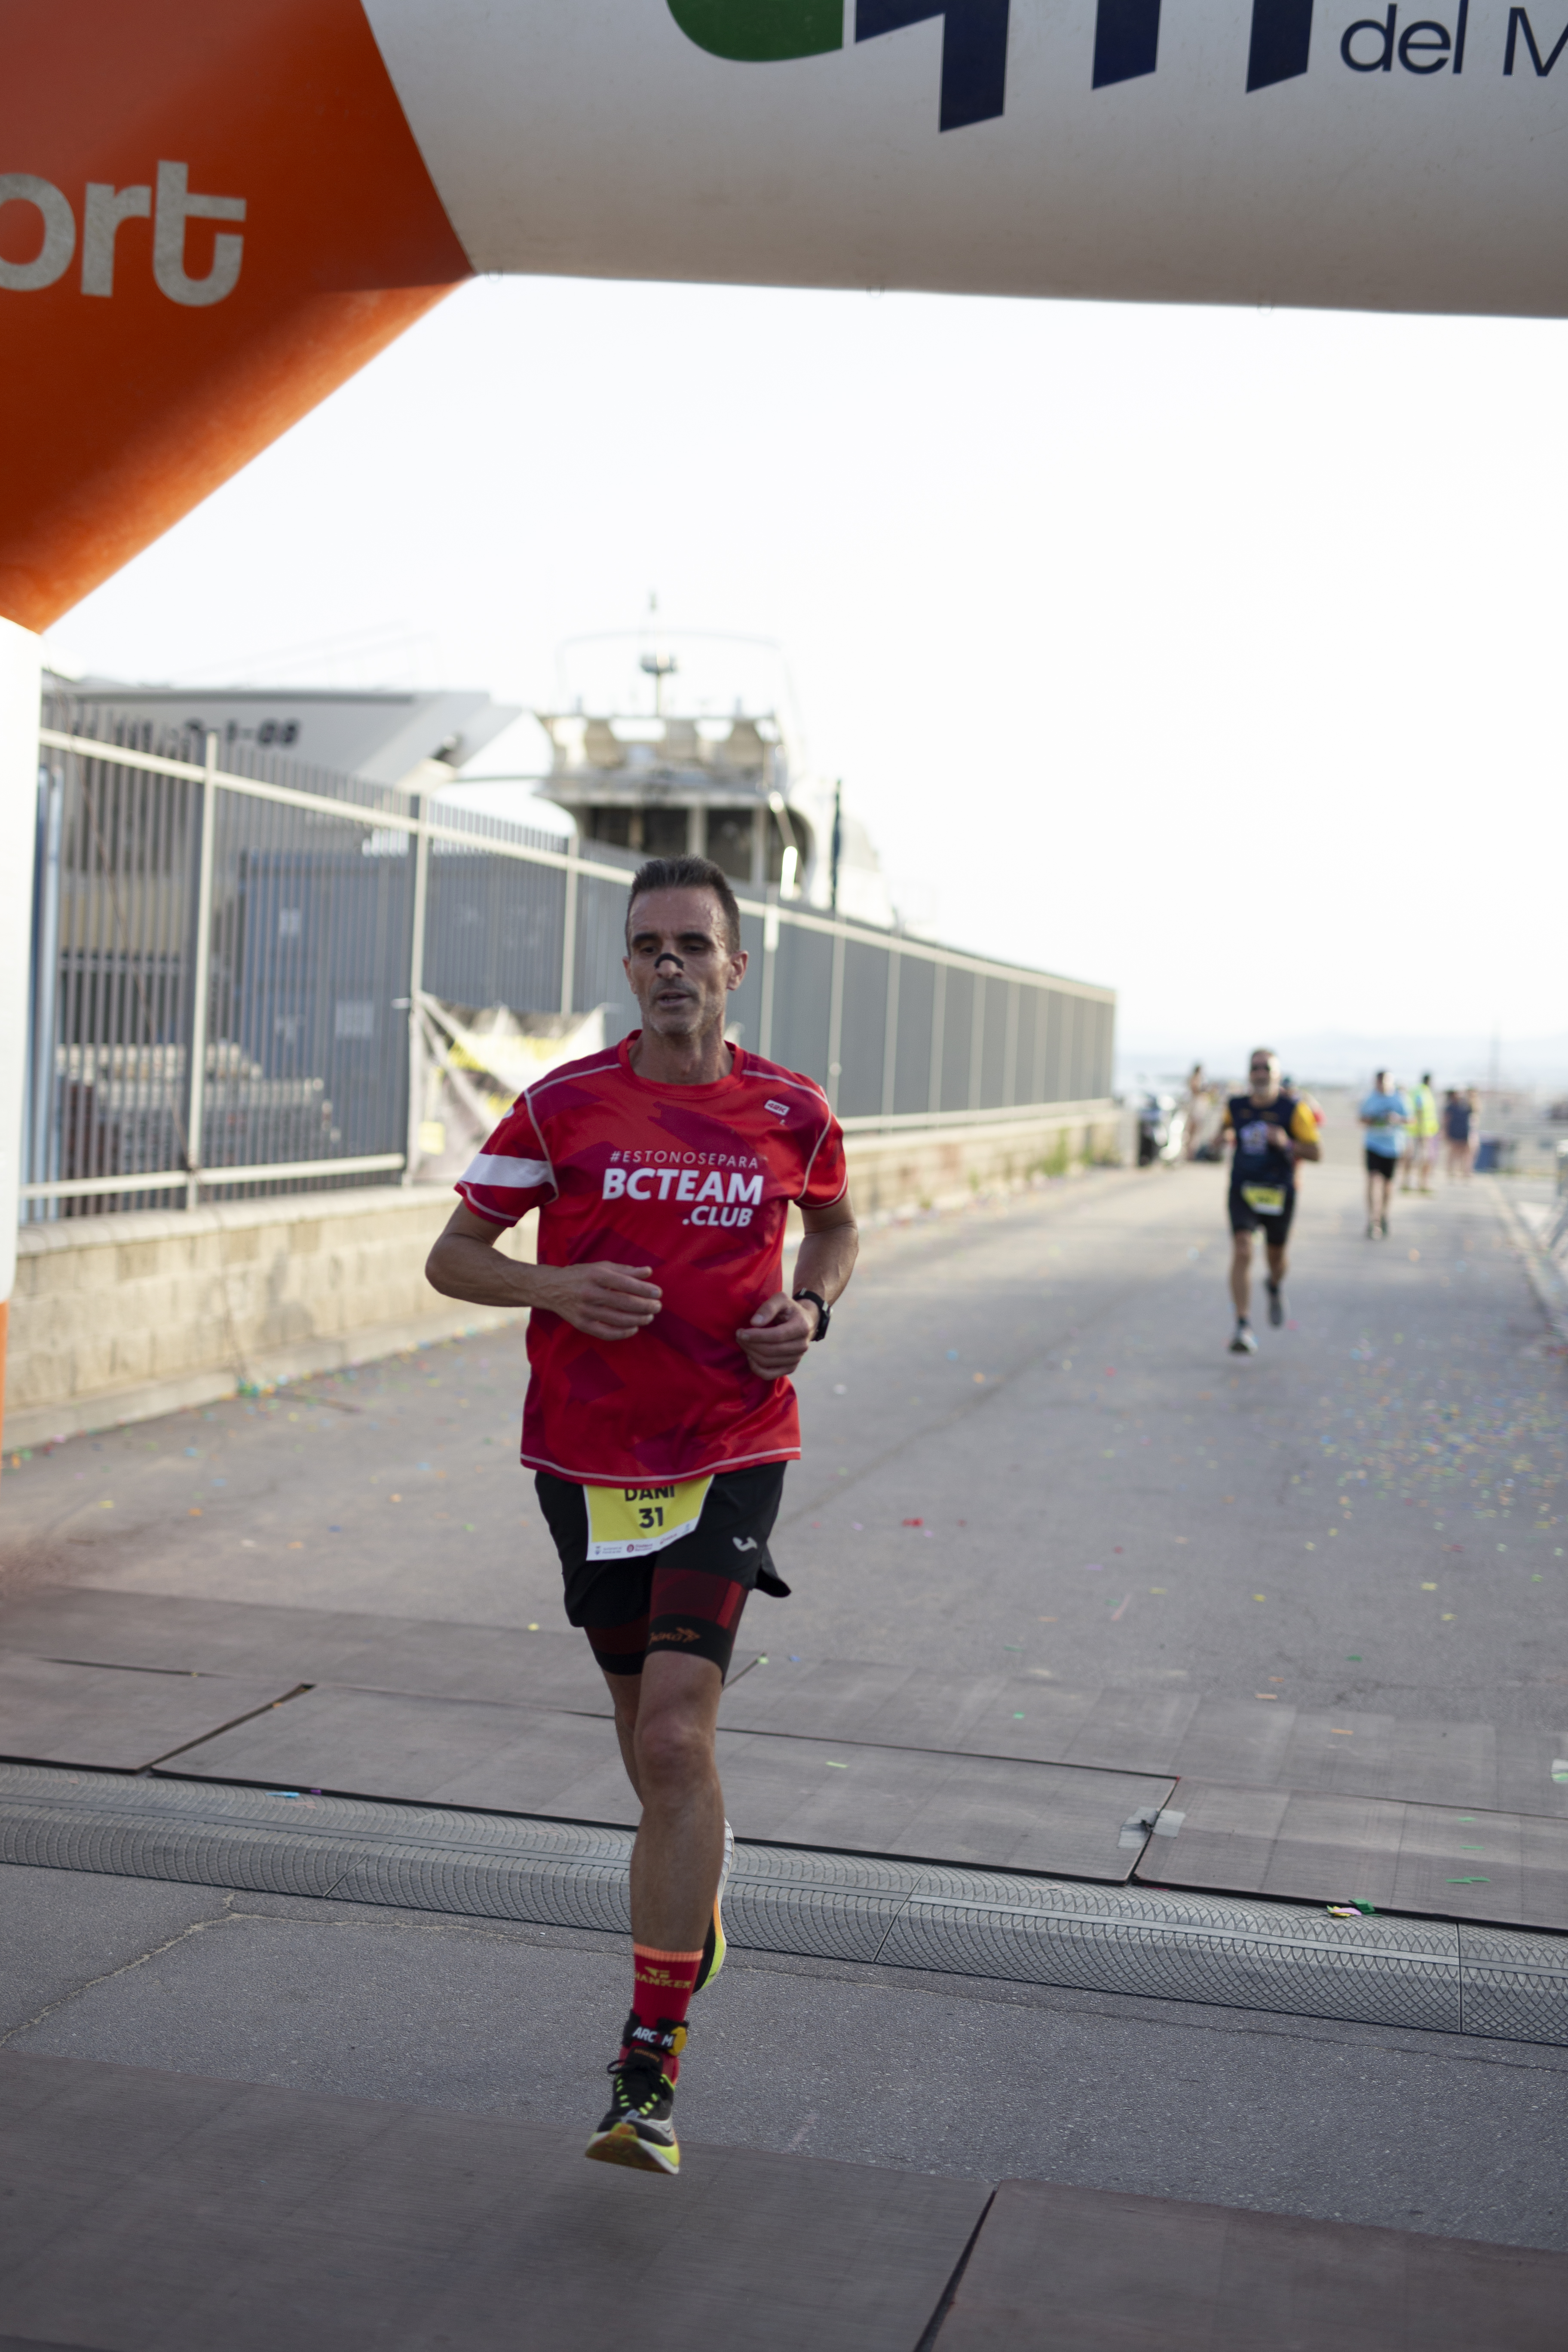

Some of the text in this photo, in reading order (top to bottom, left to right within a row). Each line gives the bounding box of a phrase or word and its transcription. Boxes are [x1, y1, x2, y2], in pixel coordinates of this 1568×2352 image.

[1340, 0, 1469, 74] del
[0, 159, 246, 307] ort
[609, 1150, 758, 1169] #ESTONOSEPARA
[602, 1167, 764, 1205] BCTEAM
[682, 1205, 753, 1227] .CLUB
[624, 1485, 675, 1501] DANI
[639, 1507, 664, 1529] 31
